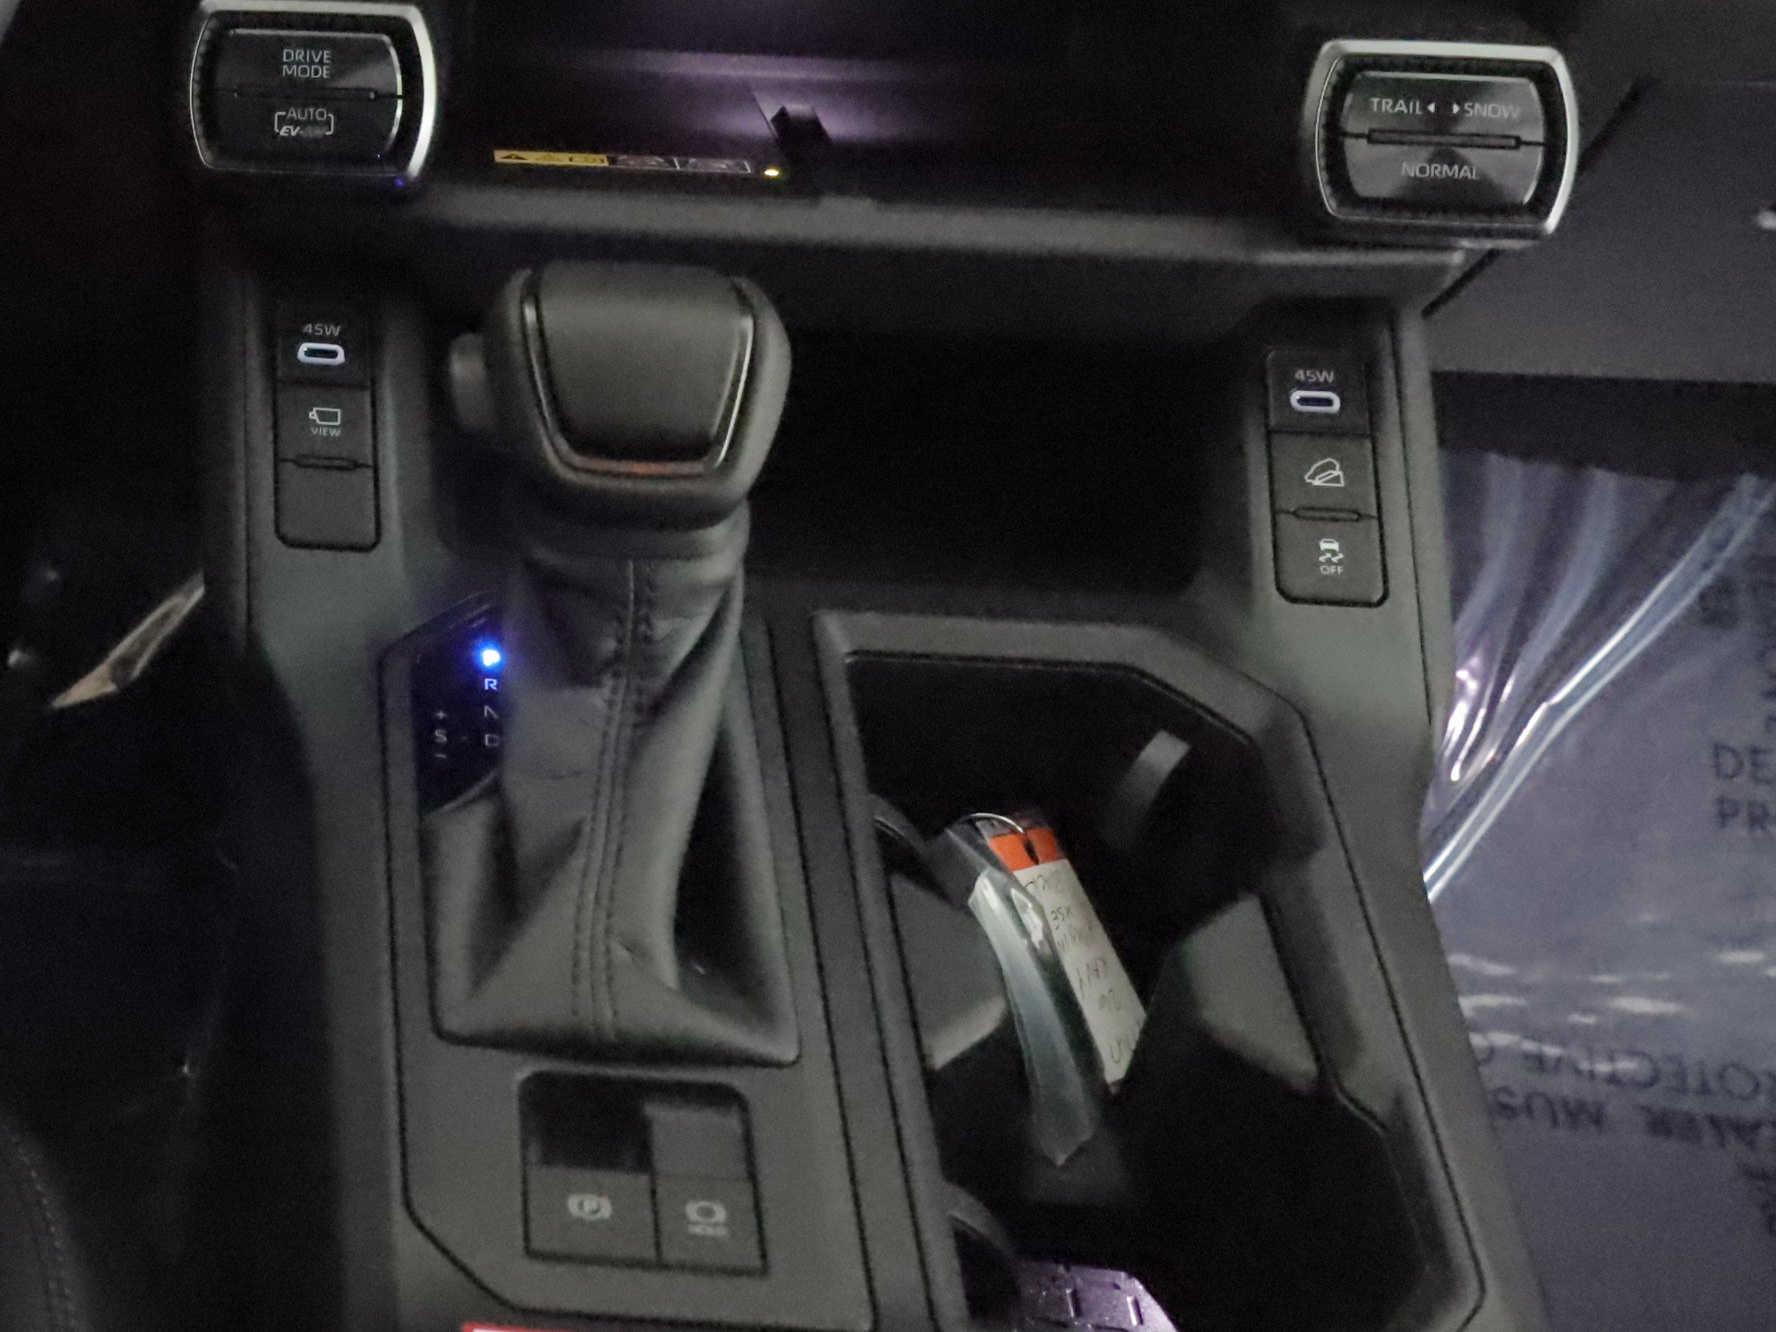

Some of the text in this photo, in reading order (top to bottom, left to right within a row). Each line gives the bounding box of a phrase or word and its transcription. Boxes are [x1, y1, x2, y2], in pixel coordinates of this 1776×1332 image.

[282, 48, 332, 63] DRIVE
[281, 65, 331, 80] MODE
[1370, 97, 1423, 116] TRAIL
[1464, 102, 1522, 119] SNOW
[286, 108, 328, 121] AUTO
[1401, 161, 1480, 181] NORMAL
[302, 322, 343, 337] 45W
[1294, 369, 1335, 384] 45W
[310, 426, 342, 438] VIEW
[1319, 565, 1344, 576] OFF
[484, 677, 499, 692] R
[435, 728, 448, 744] S
[485, 733, 500, 748] D
